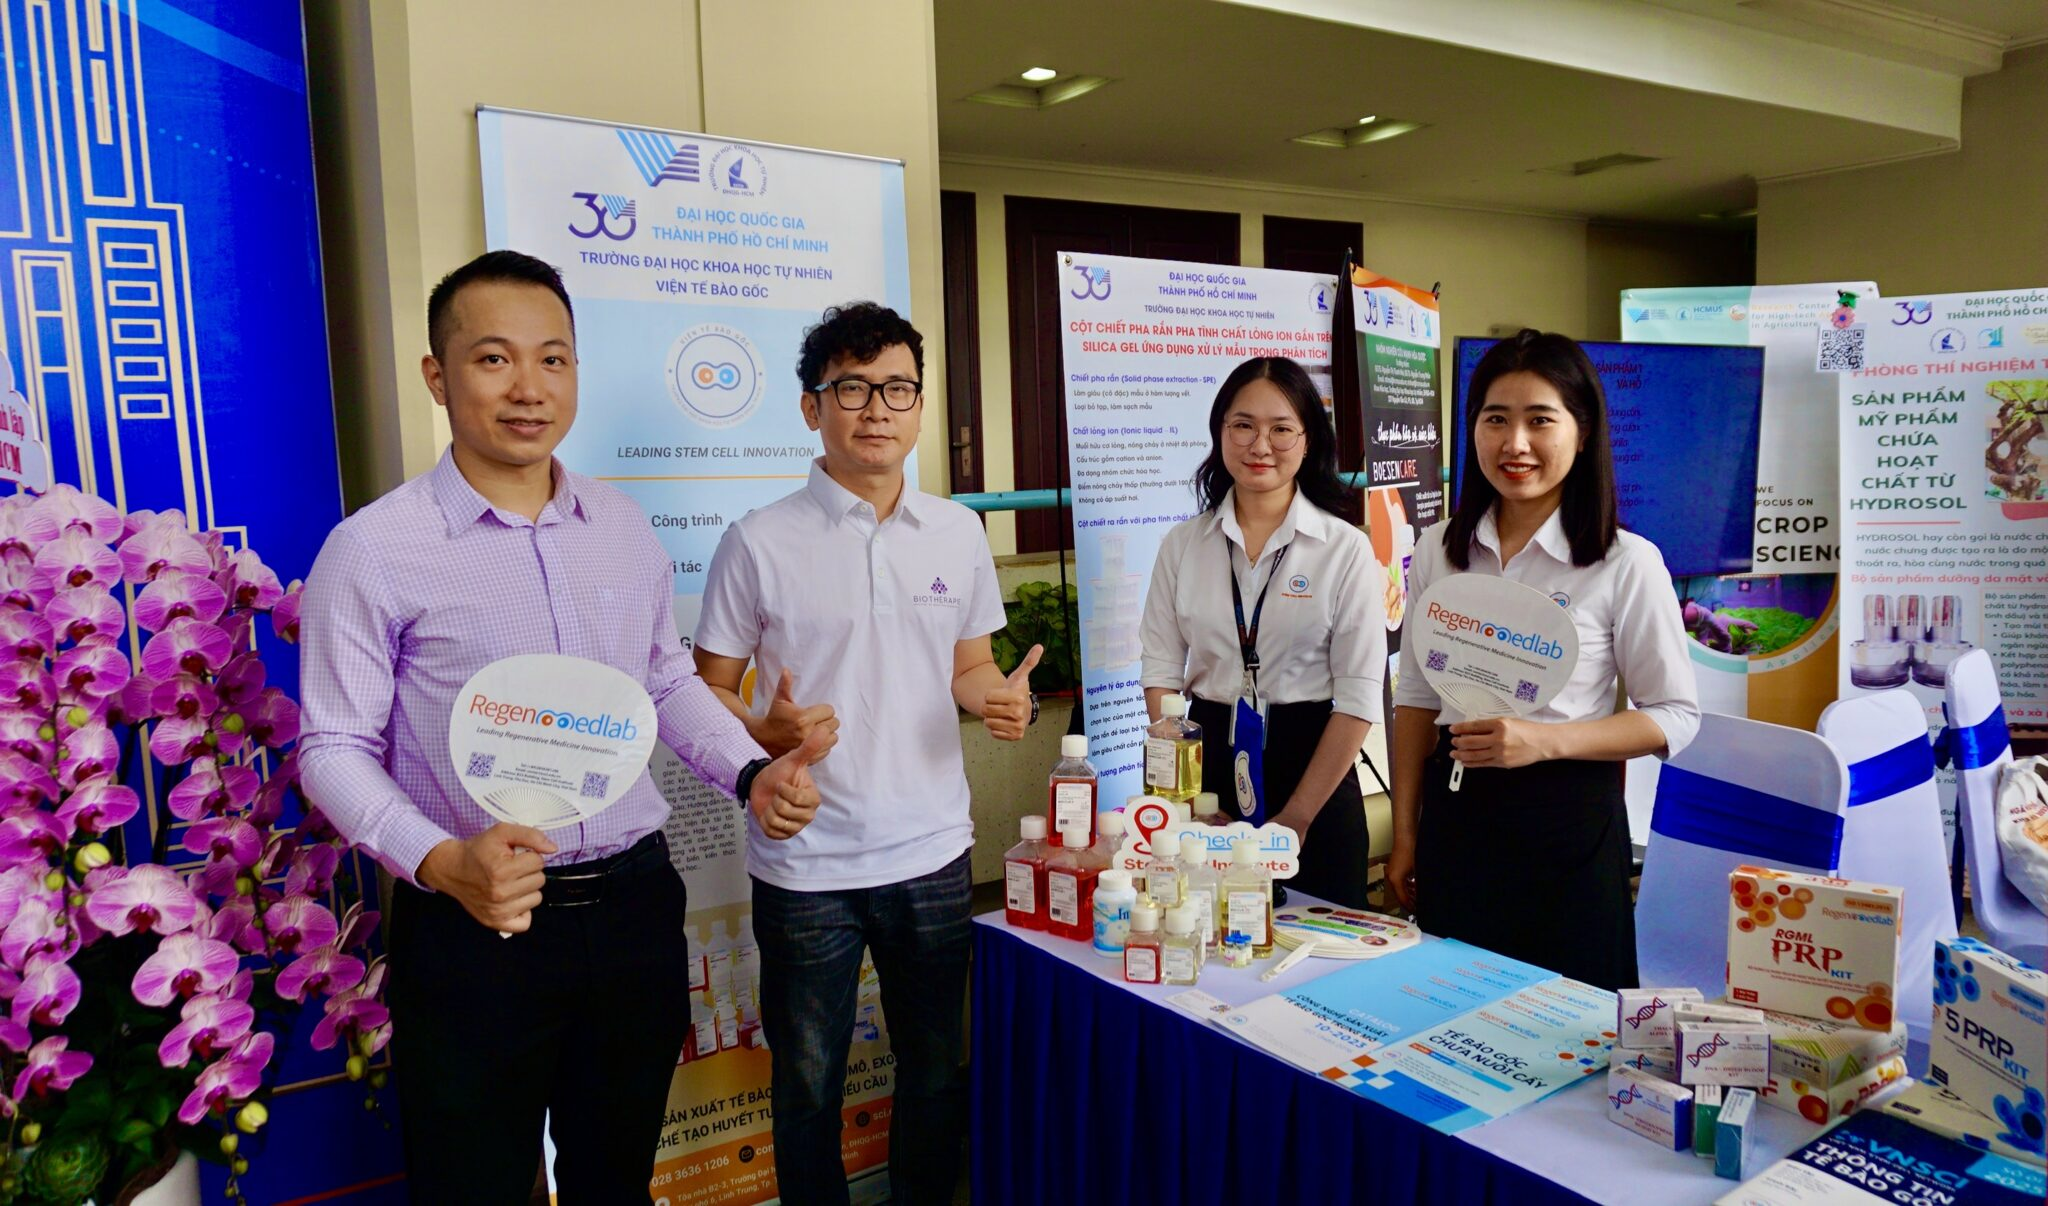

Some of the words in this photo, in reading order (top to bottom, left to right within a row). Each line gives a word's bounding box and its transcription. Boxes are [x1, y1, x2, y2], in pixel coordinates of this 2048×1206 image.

[677, 206, 701, 223] ĐẠI
[705, 210, 733, 225] HỌC
[740, 211, 778, 229] QUỐC
[782, 217, 805, 230] GIA
[652, 225, 704, 243] THÀNH
[708, 229, 738, 246] PHỐ
[742, 233, 762, 247] HỒ
[766, 235, 789, 250] CHÍ
[793, 239, 828, 252] MINH
[580, 250, 640, 267] TRƯỜNG
[644, 256, 667, 270] ĐẠI
[671, 258, 699, 273] HỌC
[703, 260, 740, 274] KHOA
[744, 263, 771, 277] HỌC
[774, 264, 792, 278] TỰ
[795, 266, 833, 281] NHIÊN
[1169, 271, 1183, 284] ĐẠI
[1186, 272, 1204, 286] HỌC
[1206, 273, 1230, 285] QUỐC
[1232, 276, 1246, 286] GIA
[656, 280, 687, 294] VIỆN
[691, 281, 708, 295] TẾ
[711, 282, 738, 297] BÀO
[742, 284, 768, 299] GỐC
[1158, 285, 1186, 297] THÀNH
[1188, 286, 1205, 298] PHỐ
[1237, 292, 1257, 301] MINH
[1965, 297, 1985, 307] ĐẠI
[1989, 296, 2010, 306] HỌC
[2012, 290, 2045, 303] QUỐC
[1694, 305, 1723, 313] HCMUS
[1752, 312, 1765, 320] for
[1768, 311, 1816, 321] High-tech
[1070, 321, 1092, 335] CỘT
[1096, 319, 1127, 334] CHIẾT
[1129, 324, 1150, 335] PHA
[1153, 323, 1173, 336] RẮN
[1176, 327, 1196, 337] PHA
[1198, 325, 1219, 338] TĨNH
[1222, 325, 1246, 339] CHẤT
[1249, 328, 1273, 340] LỎNG
[1276, 330, 1292, 341] ION
[1294, 329, 1314, 342] GẮN
[1763, 319, 1820, 329] Agriculture
[1083, 341, 1117, 352] SILICA
[1121, 342, 1139, 353] GEL
[1142, 337, 1164, 354] ỨNG
[1167, 343, 1194, 356] DỤNG
[1197, 341, 1211, 355] XỬ
[1213, 343, 1223, 356] LÝ
[1225, 341, 1247, 357] MẪU
[1249, 347, 1279, 357] TRONG
[1282, 345, 1307, 358] PHÂN
[1309, 346, 1328, 359] TÍCH
[1924, 360, 1955, 374] THÍ
[1961, 357, 2035, 373] NGHIỆM
[1071, 374, 1089, 382] Chiết
[1091, 375, 1105, 383] pha
[1107, 372, 1119, 382] rắn
[1122, 374, 1141, 383] (Solid
[1144, 375, 1164, 384] phase
[1166, 375, 1198, 383] extraction
[1203, 375, 1216, 384] SPE)
[1852, 389, 1895, 406] SẢN
[1903, 386, 1965, 404] PHẨM
[1859, 411, 1889, 426] MỸ
[1895, 407, 1958, 425] PHẨM
[1073, 426, 1089, 435] Chất
[1143, 427, 1163, 435] liquid
[1878, 430, 1938, 447] CHỨA
[617, 447, 672, 458] LEADING
[675, 447, 709, 458] STEM
[712, 447, 740, 457] CELL
[743, 447, 815, 457] INNOVATION
[1373, 459, 1418, 481] BOESENCARE
[1878, 455, 1938, 470] HOẠT
[1861, 472, 1919, 489] CHẤT
[1926, 473, 1956, 488] TỪ
[1756, 498, 1793, 506] FOCUS
[1798, 498, 1813, 506] ON
[1850, 496, 1967, 510] HYDROSOL
[652, 511, 688, 530] Công
[691, 512, 723, 528] trình
[1078, 519, 1088, 528] Cột
[1090, 517, 1106, 527] chiết
[1757, 516, 1828, 534] CROP
[1857, 533, 1920, 541] HYDROSOL
[1923, 534, 1943, 543] hay
[1947, 532, 1966, 541] còn
[1970, 533, 1987, 543] gọi
[681, 560, 702, 574] tác
[1851, 574, 1867, 584] Bộ
[1871, 573, 1893, 583] sản
[1897, 572, 1934, 585] phẩm
[1938, 573, 1980, 585] dưỡng
[1984, 575, 2000, 583] da
[2005, 574, 2032, 584] mặt
[1455, 636, 1491, 652] Regenerative
[1491, 647, 1516, 661] Medicine
[1086, 683, 1107, 695] Nguyên
[476, 726, 504, 738] Leading
[504, 731, 549, 745] Regenerative
[550, 739, 580, 751] Medicine
[581, 744, 618, 757] Innovation
[1271, 832, 1290, 848] in
[1776, 928, 1813, 943] RGML
[1771, 939, 1843, 974] PRP
[1831, 969, 1854, 980] KIT
[1315, 1022, 1367, 1049] 10-2023
[1945, 1007, 1959, 1033] 5
[1963, 1017, 2014, 1060] PRP
[2004, 1058, 2029, 1081] KIT
[1443, 1029, 1466, 1042] TẾ
[1462, 1037, 1497, 1055] BÀO
[1494, 1051, 1529, 1070] GỐC
[848, 1059, 870, 1076] MÔ,
[1429, 1034, 1471, 1061] CHƯA
[1471, 1054, 1515, 1076] NUÔI
[1513, 1070, 1548, 1089] CẤY
[864, 1074, 888, 1092] CẦU
[661, 1108, 688, 1127] SẢN
[691, 1098, 725, 1118] XUẤT
[729, 1090, 746, 1108] TẾ
[748, 1086, 773, 1104] BÀO
[683, 1123, 709, 1143] TẠO
[713, 1111, 754, 1134] HUYẾT
[651, 1173, 673, 1187] 028
[675, 1165, 701, 1181] 3636
[704, 1156, 730, 1173] 1206
[1803, 1151, 1835, 1168] TẾ
[1833, 1164, 1888, 1192] BÀO
[1869, 1139, 1969, 1189] VNSCI
[1815, 1142, 1905, 1184] THÔNG
[1908, 1180, 1955, 1206] TIN
